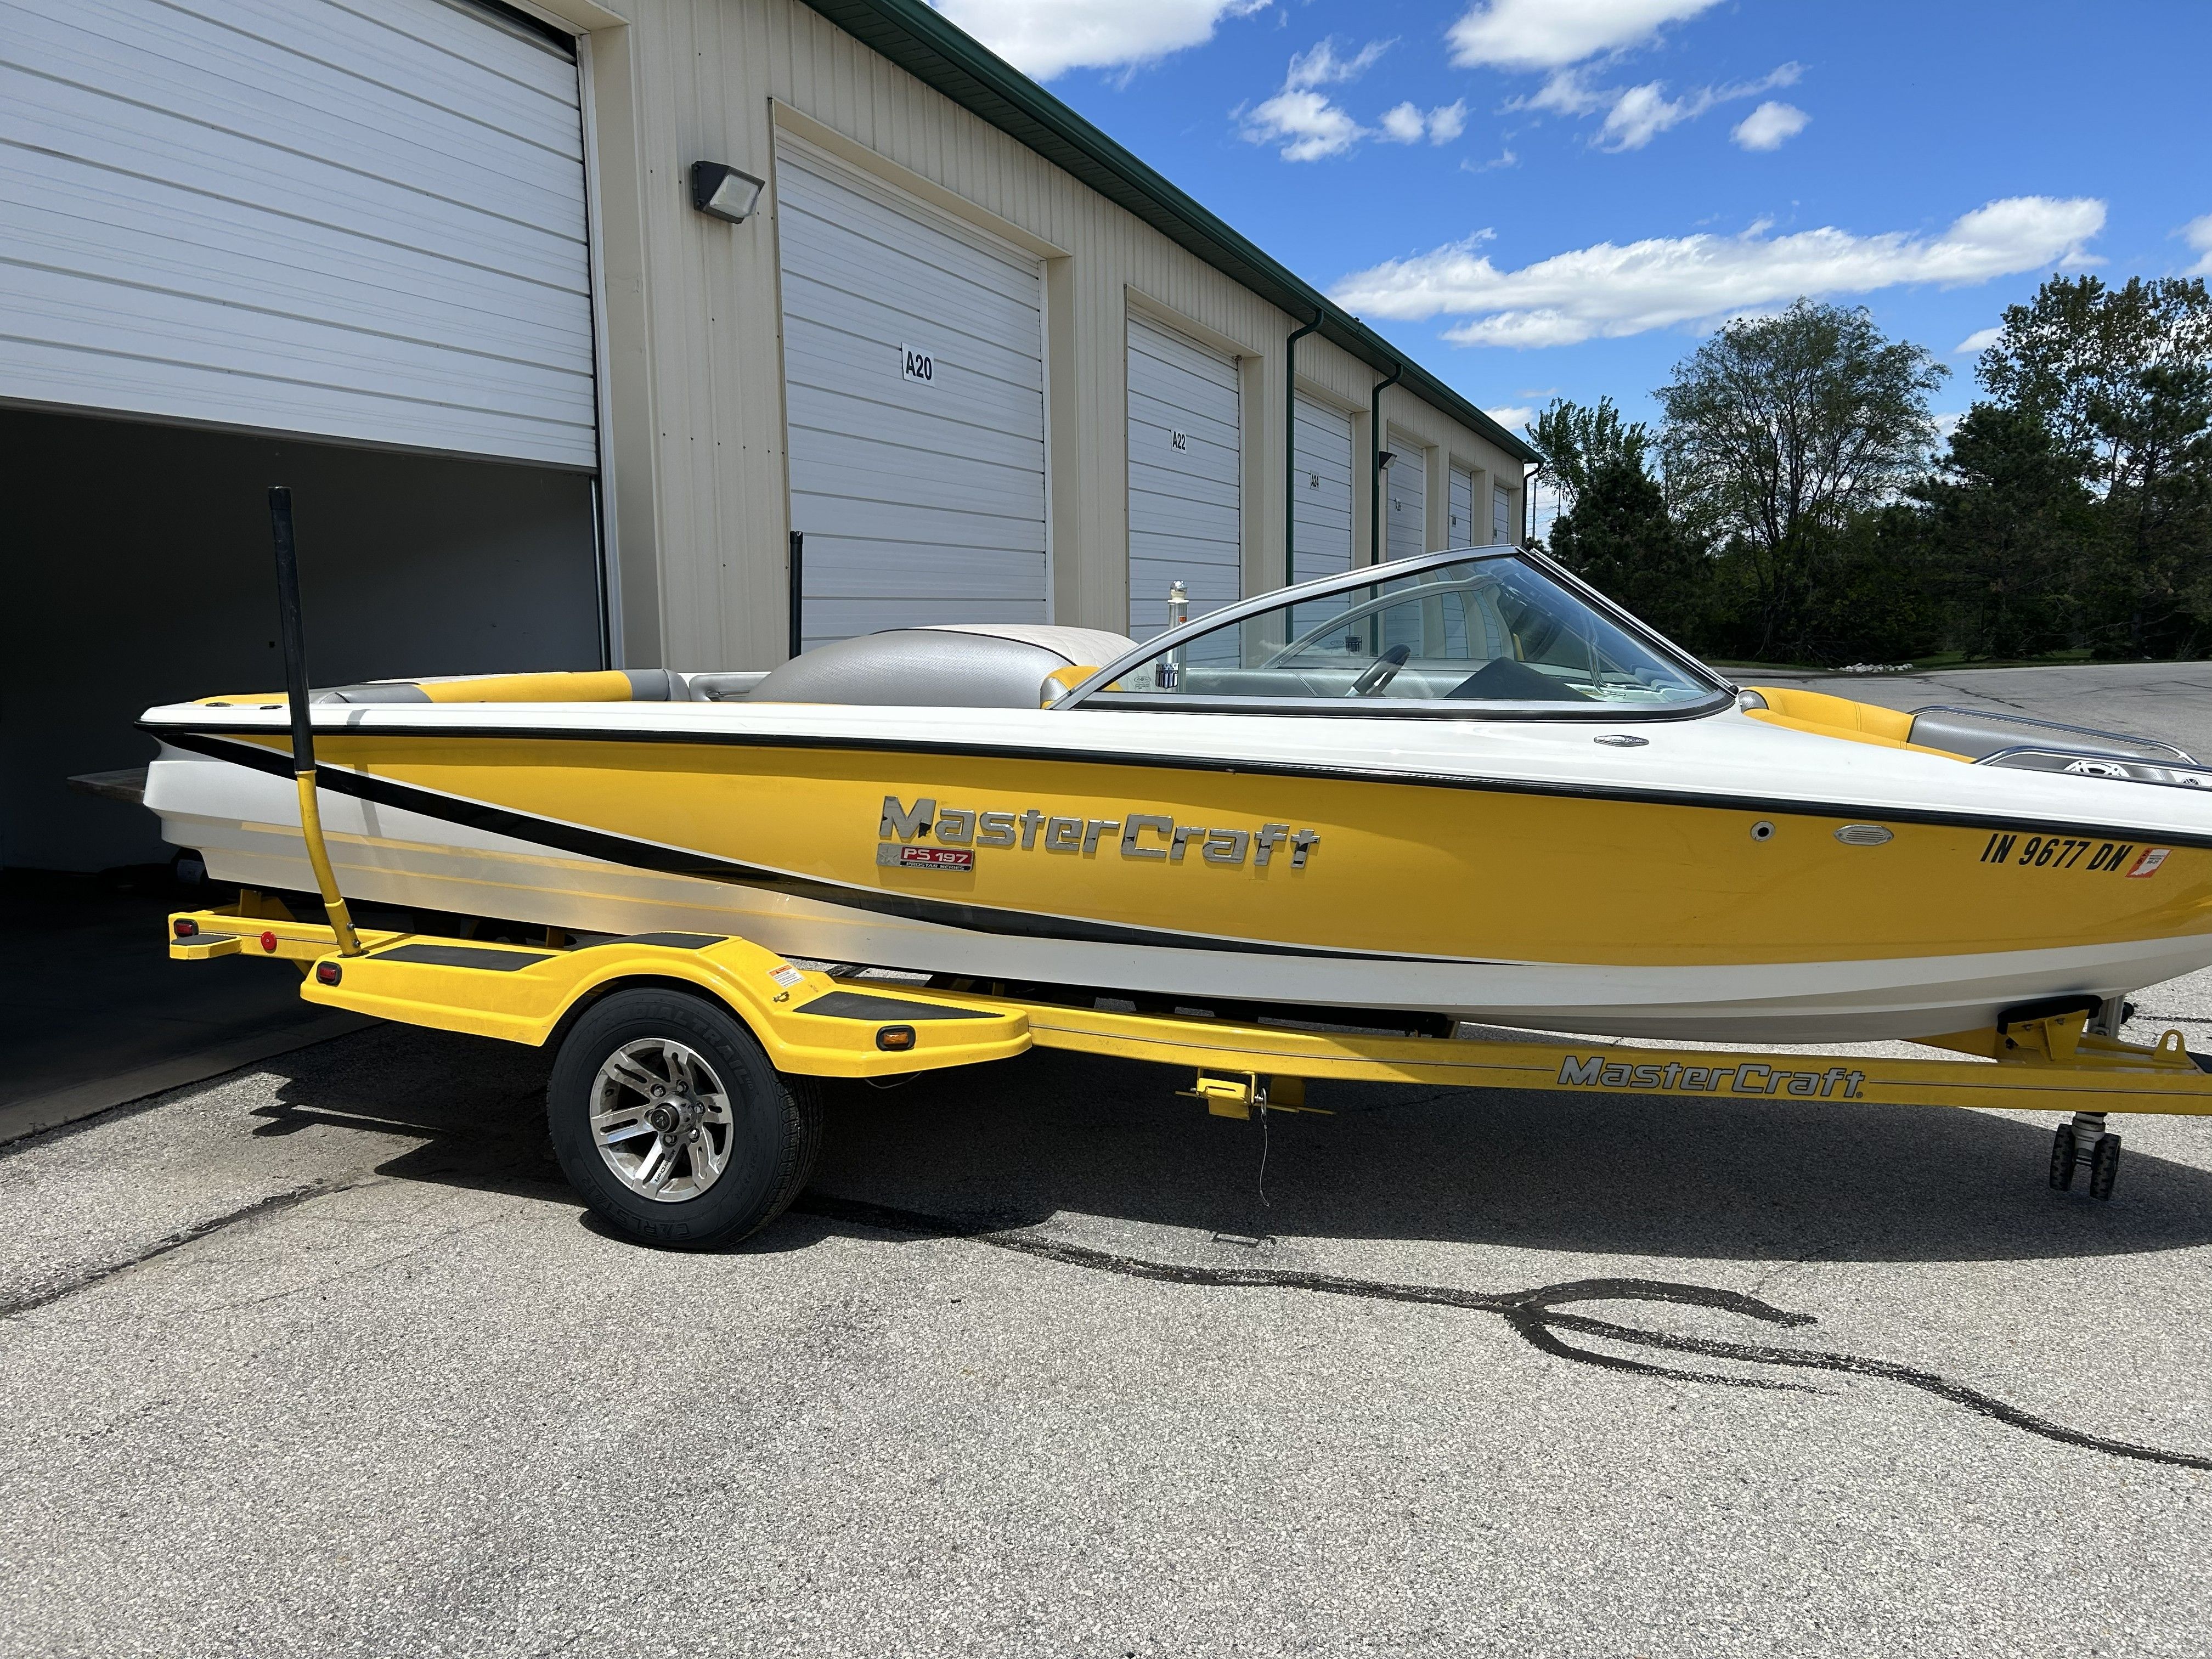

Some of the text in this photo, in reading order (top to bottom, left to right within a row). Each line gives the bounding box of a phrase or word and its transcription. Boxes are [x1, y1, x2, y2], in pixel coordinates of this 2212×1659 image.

[906, 351, 932, 380] A20
[1173, 431, 1185, 450] A22
[879, 795, 1321, 868] MasterCraft
[904, 848, 968, 863] PS 197
[1980, 833, 2134, 871] IN 9677 DN
[691, 1017, 748, 1085] TRAIL
[1557, 1056, 1865, 1098] MasterCraft
